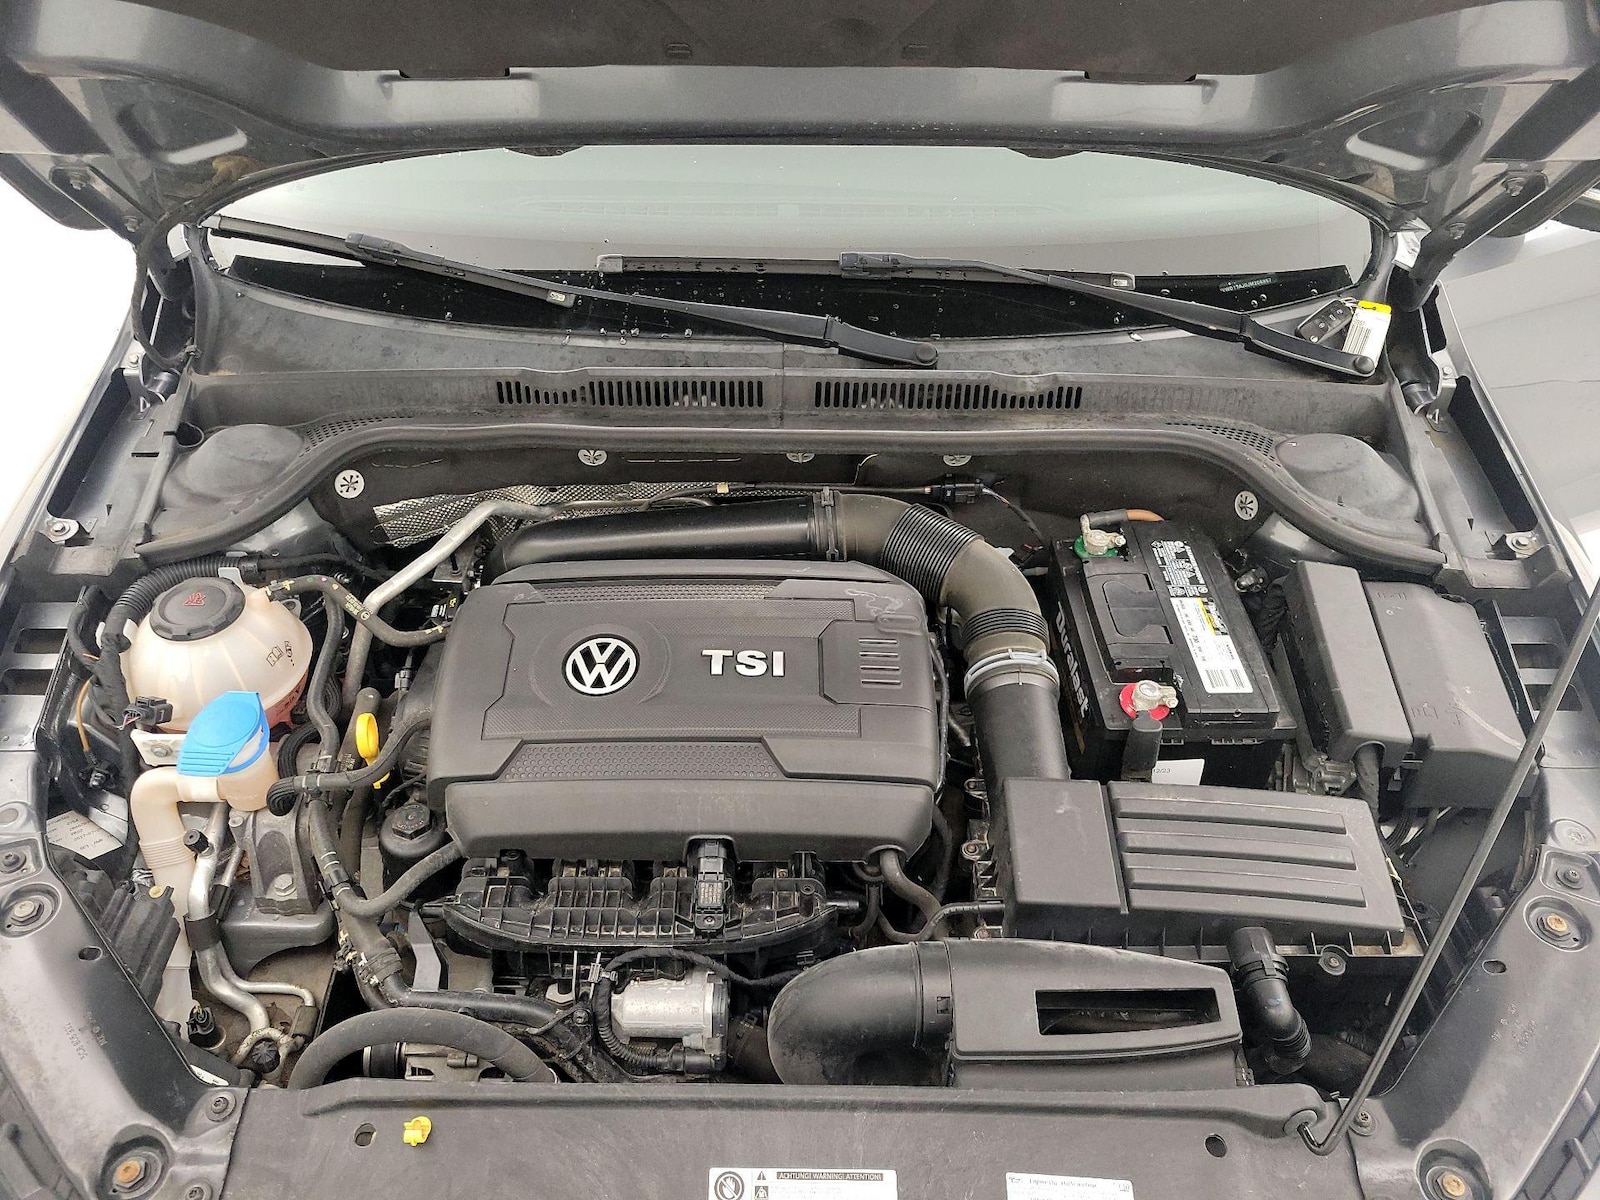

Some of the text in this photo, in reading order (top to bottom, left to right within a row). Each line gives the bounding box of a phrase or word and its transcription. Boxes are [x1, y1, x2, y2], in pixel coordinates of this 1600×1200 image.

[565, 637, 638, 695] VW
[702, 649, 786, 677] TSI
[1056, 601, 1089, 718] Duralast
[778, 1172, 882, 1181] ACHTUNG! WARNING! ATTENTION!
